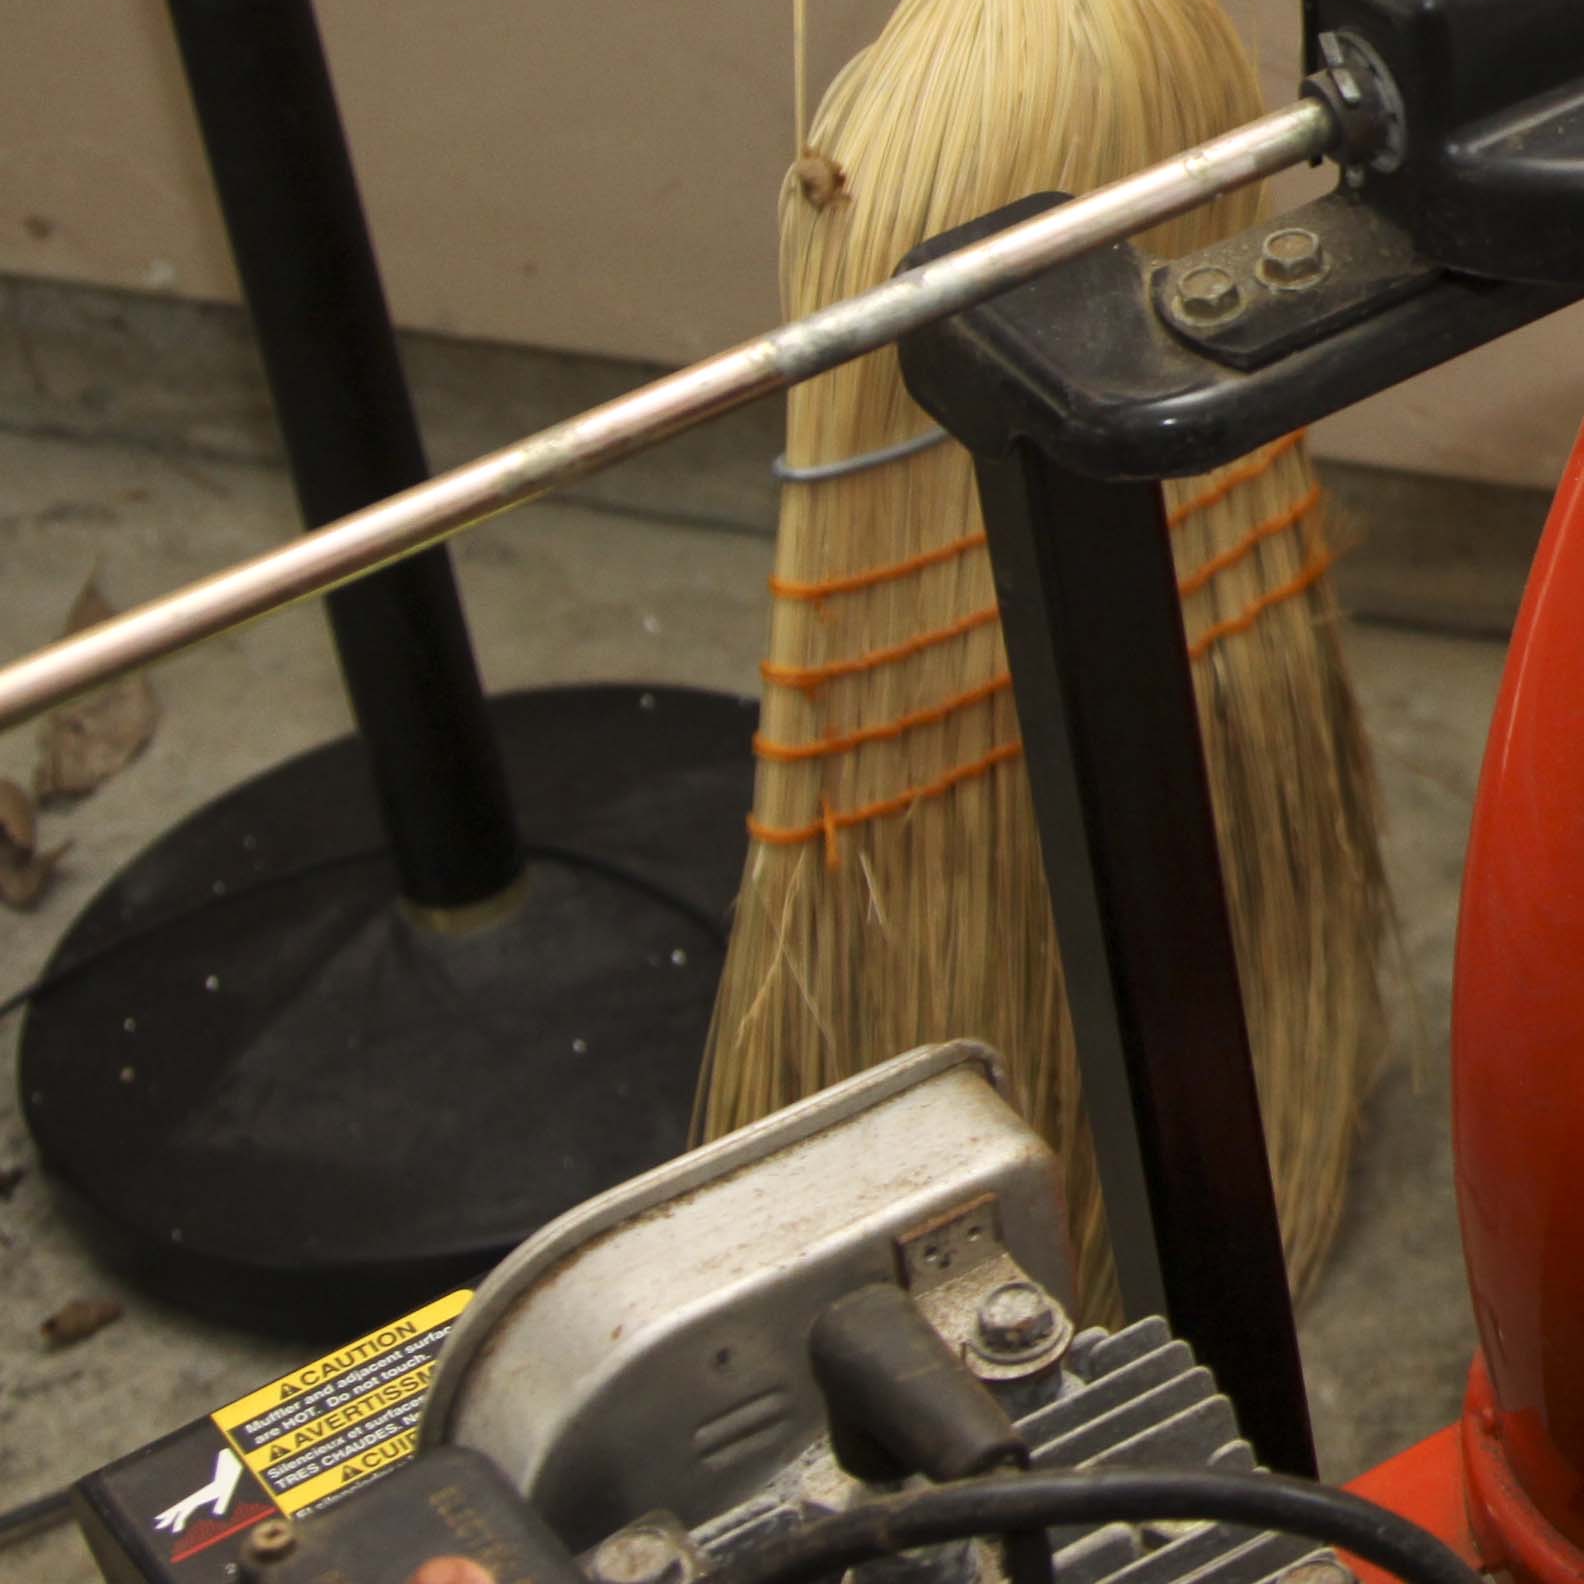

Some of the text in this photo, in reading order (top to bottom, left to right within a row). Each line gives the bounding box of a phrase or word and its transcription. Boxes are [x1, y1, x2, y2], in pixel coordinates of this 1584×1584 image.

[300, 1322, 416, 1384] CAUTION
[244, 1400, 302, 1434] Muffler
[302, 1382, 336, 1406] and
[334, 1349, 404, 1390] adjacent
[252, 1352, 432, 1445] are HOT. Do not touch.
[266, 1434, 346, 1480] Silencieux
[346, 1426, 364, 1440] et
[274, 1462, 320, 1490] TRES
[319, 1422, 403, 1467] CHAUDES.
